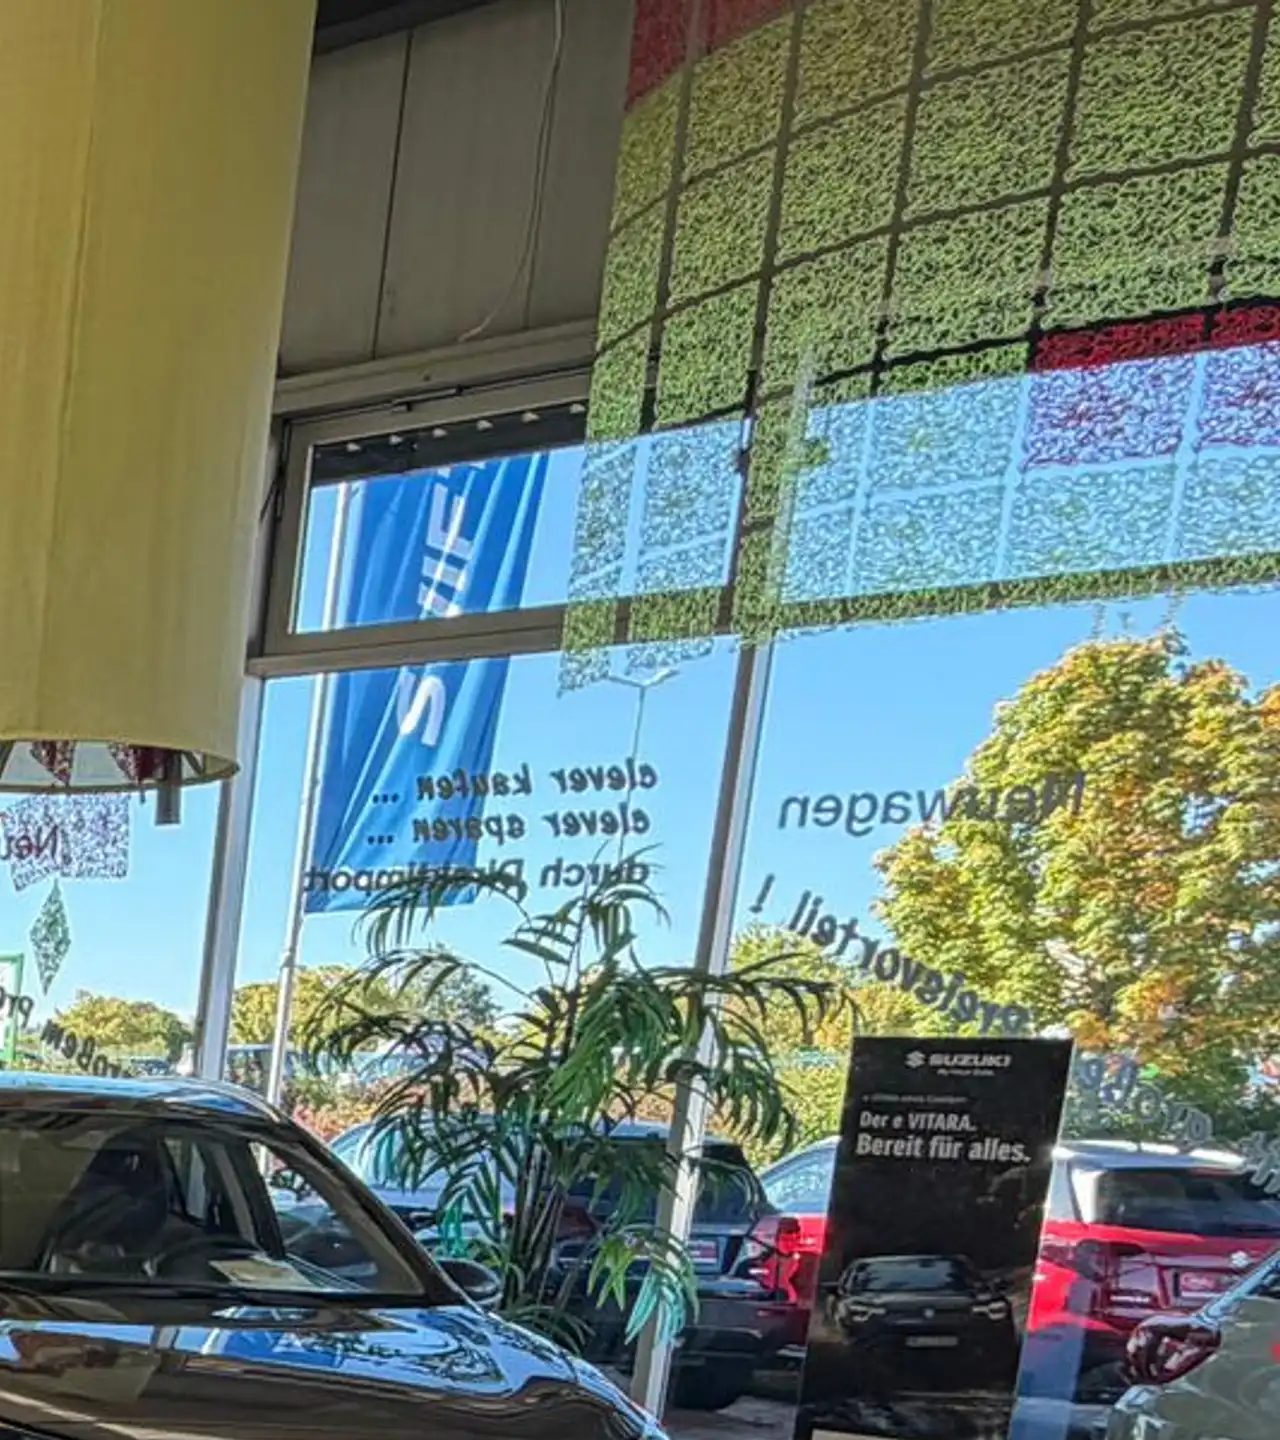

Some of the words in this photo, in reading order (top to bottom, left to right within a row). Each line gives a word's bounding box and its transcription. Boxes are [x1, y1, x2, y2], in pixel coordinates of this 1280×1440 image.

[860, 1110, 887, 1128] Der
[893, 1114, 903, 1125] e
[907, 1113, 978, 1133] VITARA.
[856, 1133, 922, 1157] Bereit
[929, 1136, 961, 1160] für
[968, 1138, 1032, 1163] alles.
